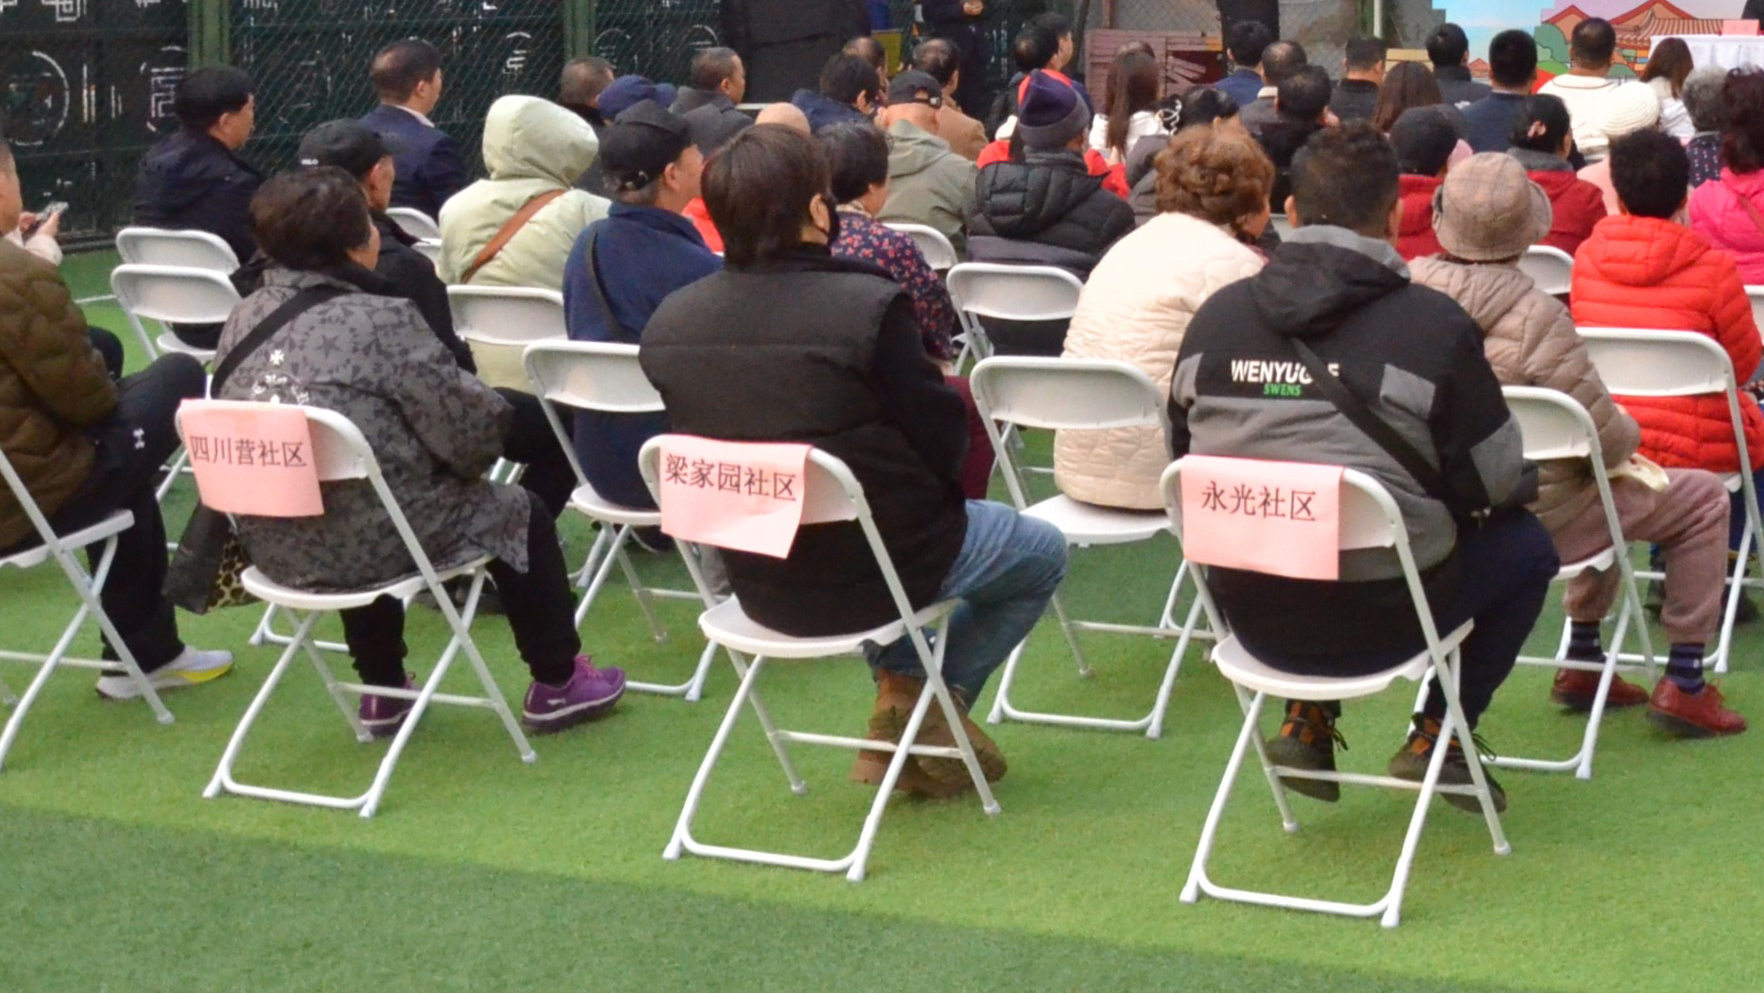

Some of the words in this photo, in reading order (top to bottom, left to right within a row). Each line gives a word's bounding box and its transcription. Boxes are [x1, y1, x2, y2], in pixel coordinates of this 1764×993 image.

[189, 435, 308, 468] 四川营社区
[664, 453, 797, 502] 梁家园社区
[1202, 480, 1317, 522] 永光社区
